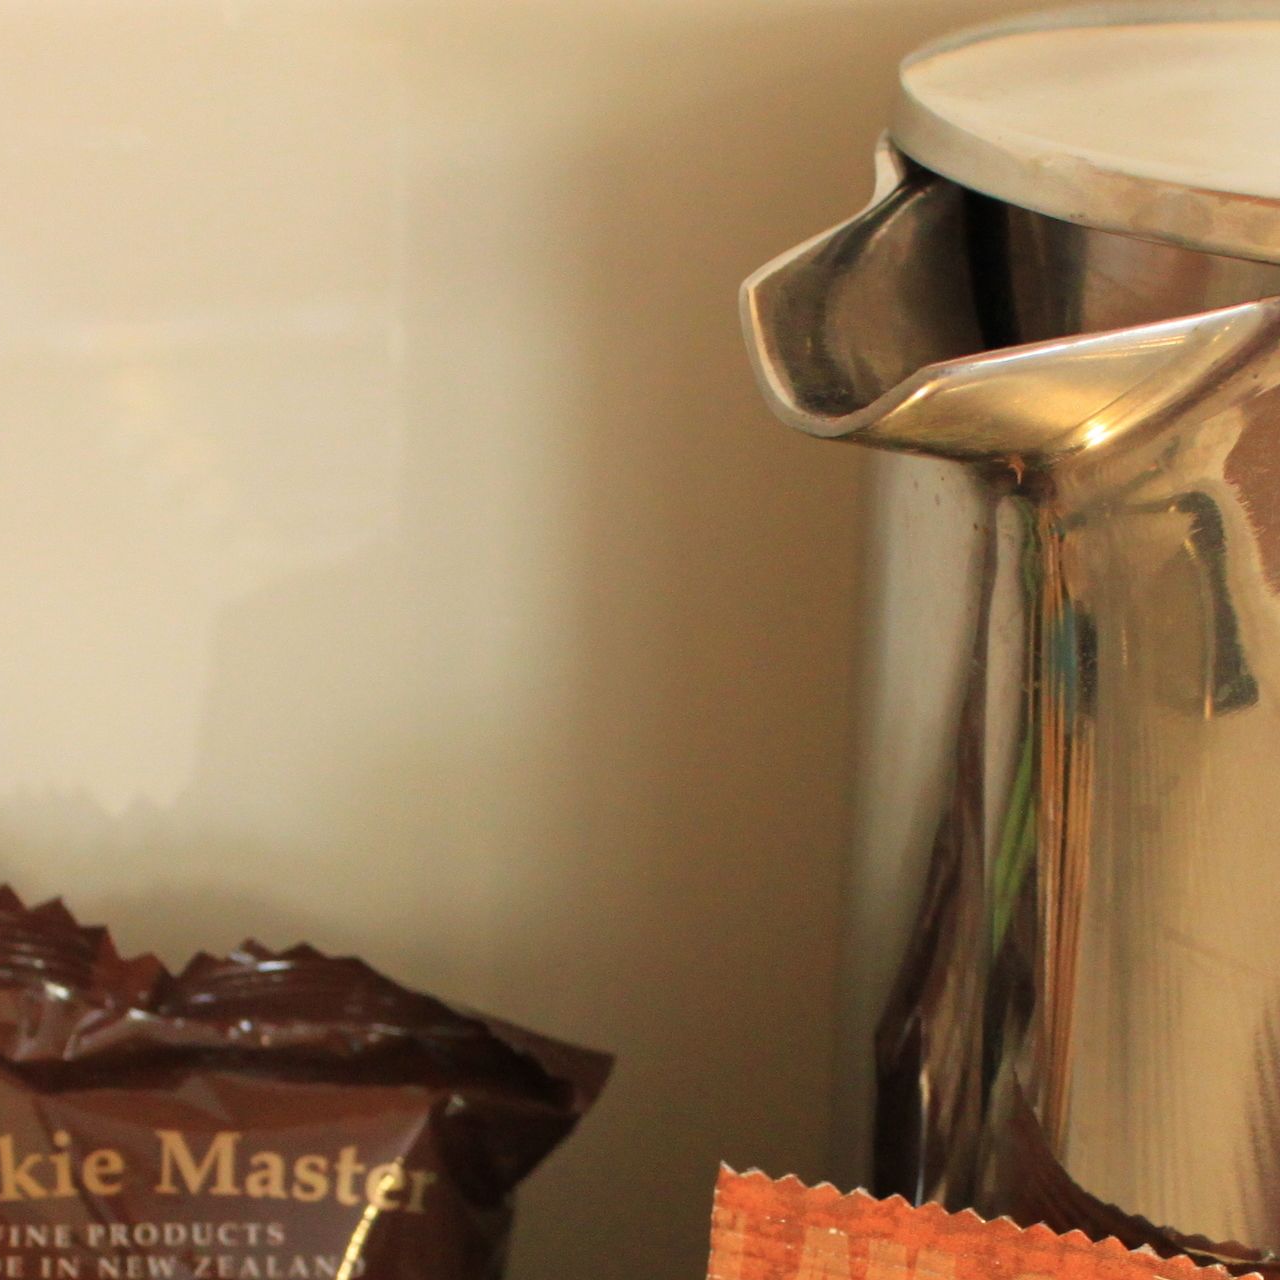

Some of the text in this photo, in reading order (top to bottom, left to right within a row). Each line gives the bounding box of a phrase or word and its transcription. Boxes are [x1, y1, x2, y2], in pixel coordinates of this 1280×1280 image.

[154, 1128, 437, 1213] Master
[87, 1221, 286, 1248] PRODUCTS
[41, 1255, 80, 1279] IN
[97, 1255, 177, 1280] NEW
